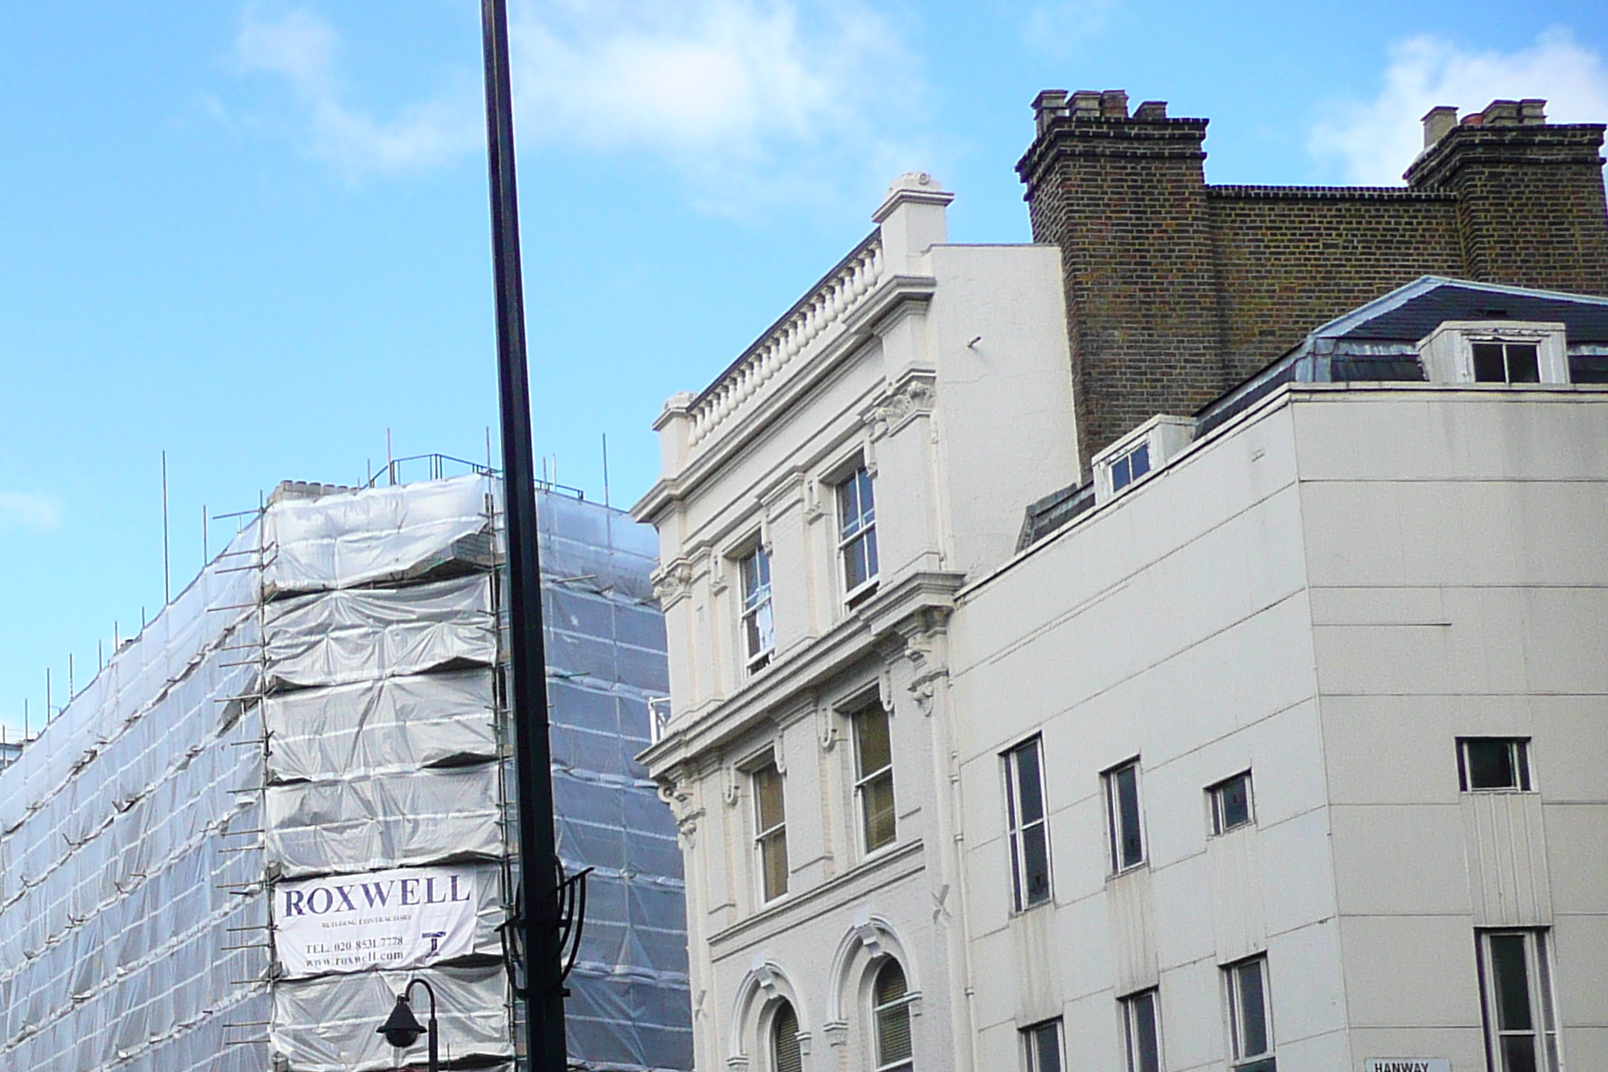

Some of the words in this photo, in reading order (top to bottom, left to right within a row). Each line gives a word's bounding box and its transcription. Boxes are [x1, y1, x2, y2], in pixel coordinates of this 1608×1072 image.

[283, 875, 471, 918] ROXWELL
[334, 942, 352, 951] 020
[356, 939, 376, 950] 8531
